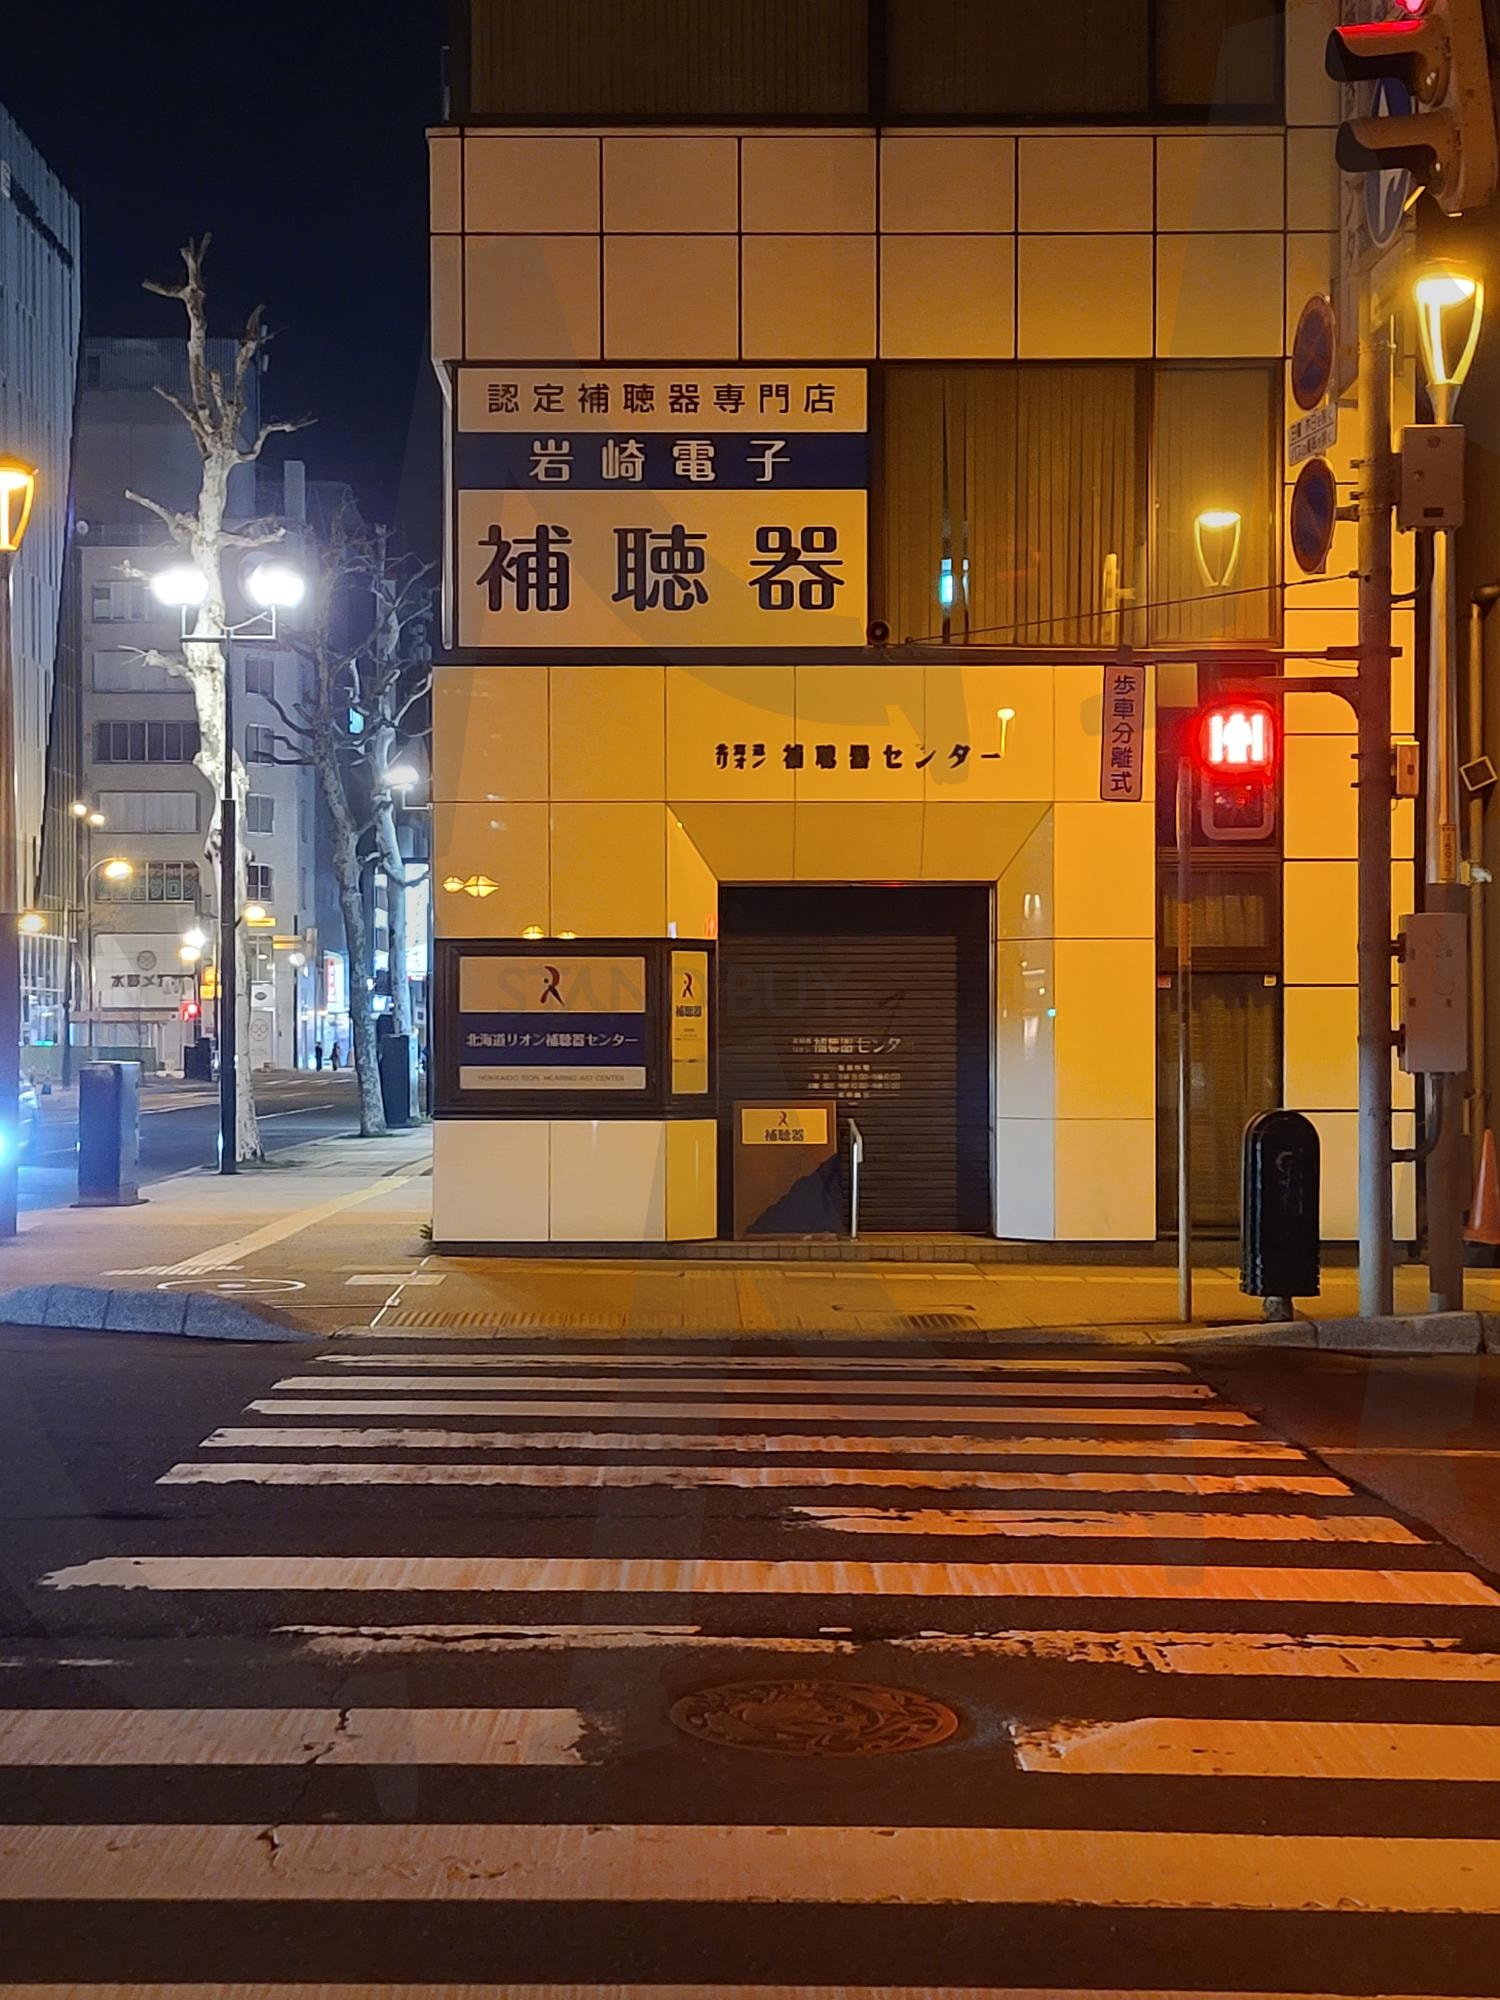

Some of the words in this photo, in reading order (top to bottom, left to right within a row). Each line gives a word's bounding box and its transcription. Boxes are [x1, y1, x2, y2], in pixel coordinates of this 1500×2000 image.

[488, 384, 835, 414] 認定補聴器専門店
[529, 439, 791, 482] 岩崎電子
[476, 524, 845, 612] 補聴器
[1110, 675, 1136, 793] 歩車分離式
[111, 974, 194, 992] 水野メ
[466, 1033, 638, 1047] 北海道リオン補聴器センター
